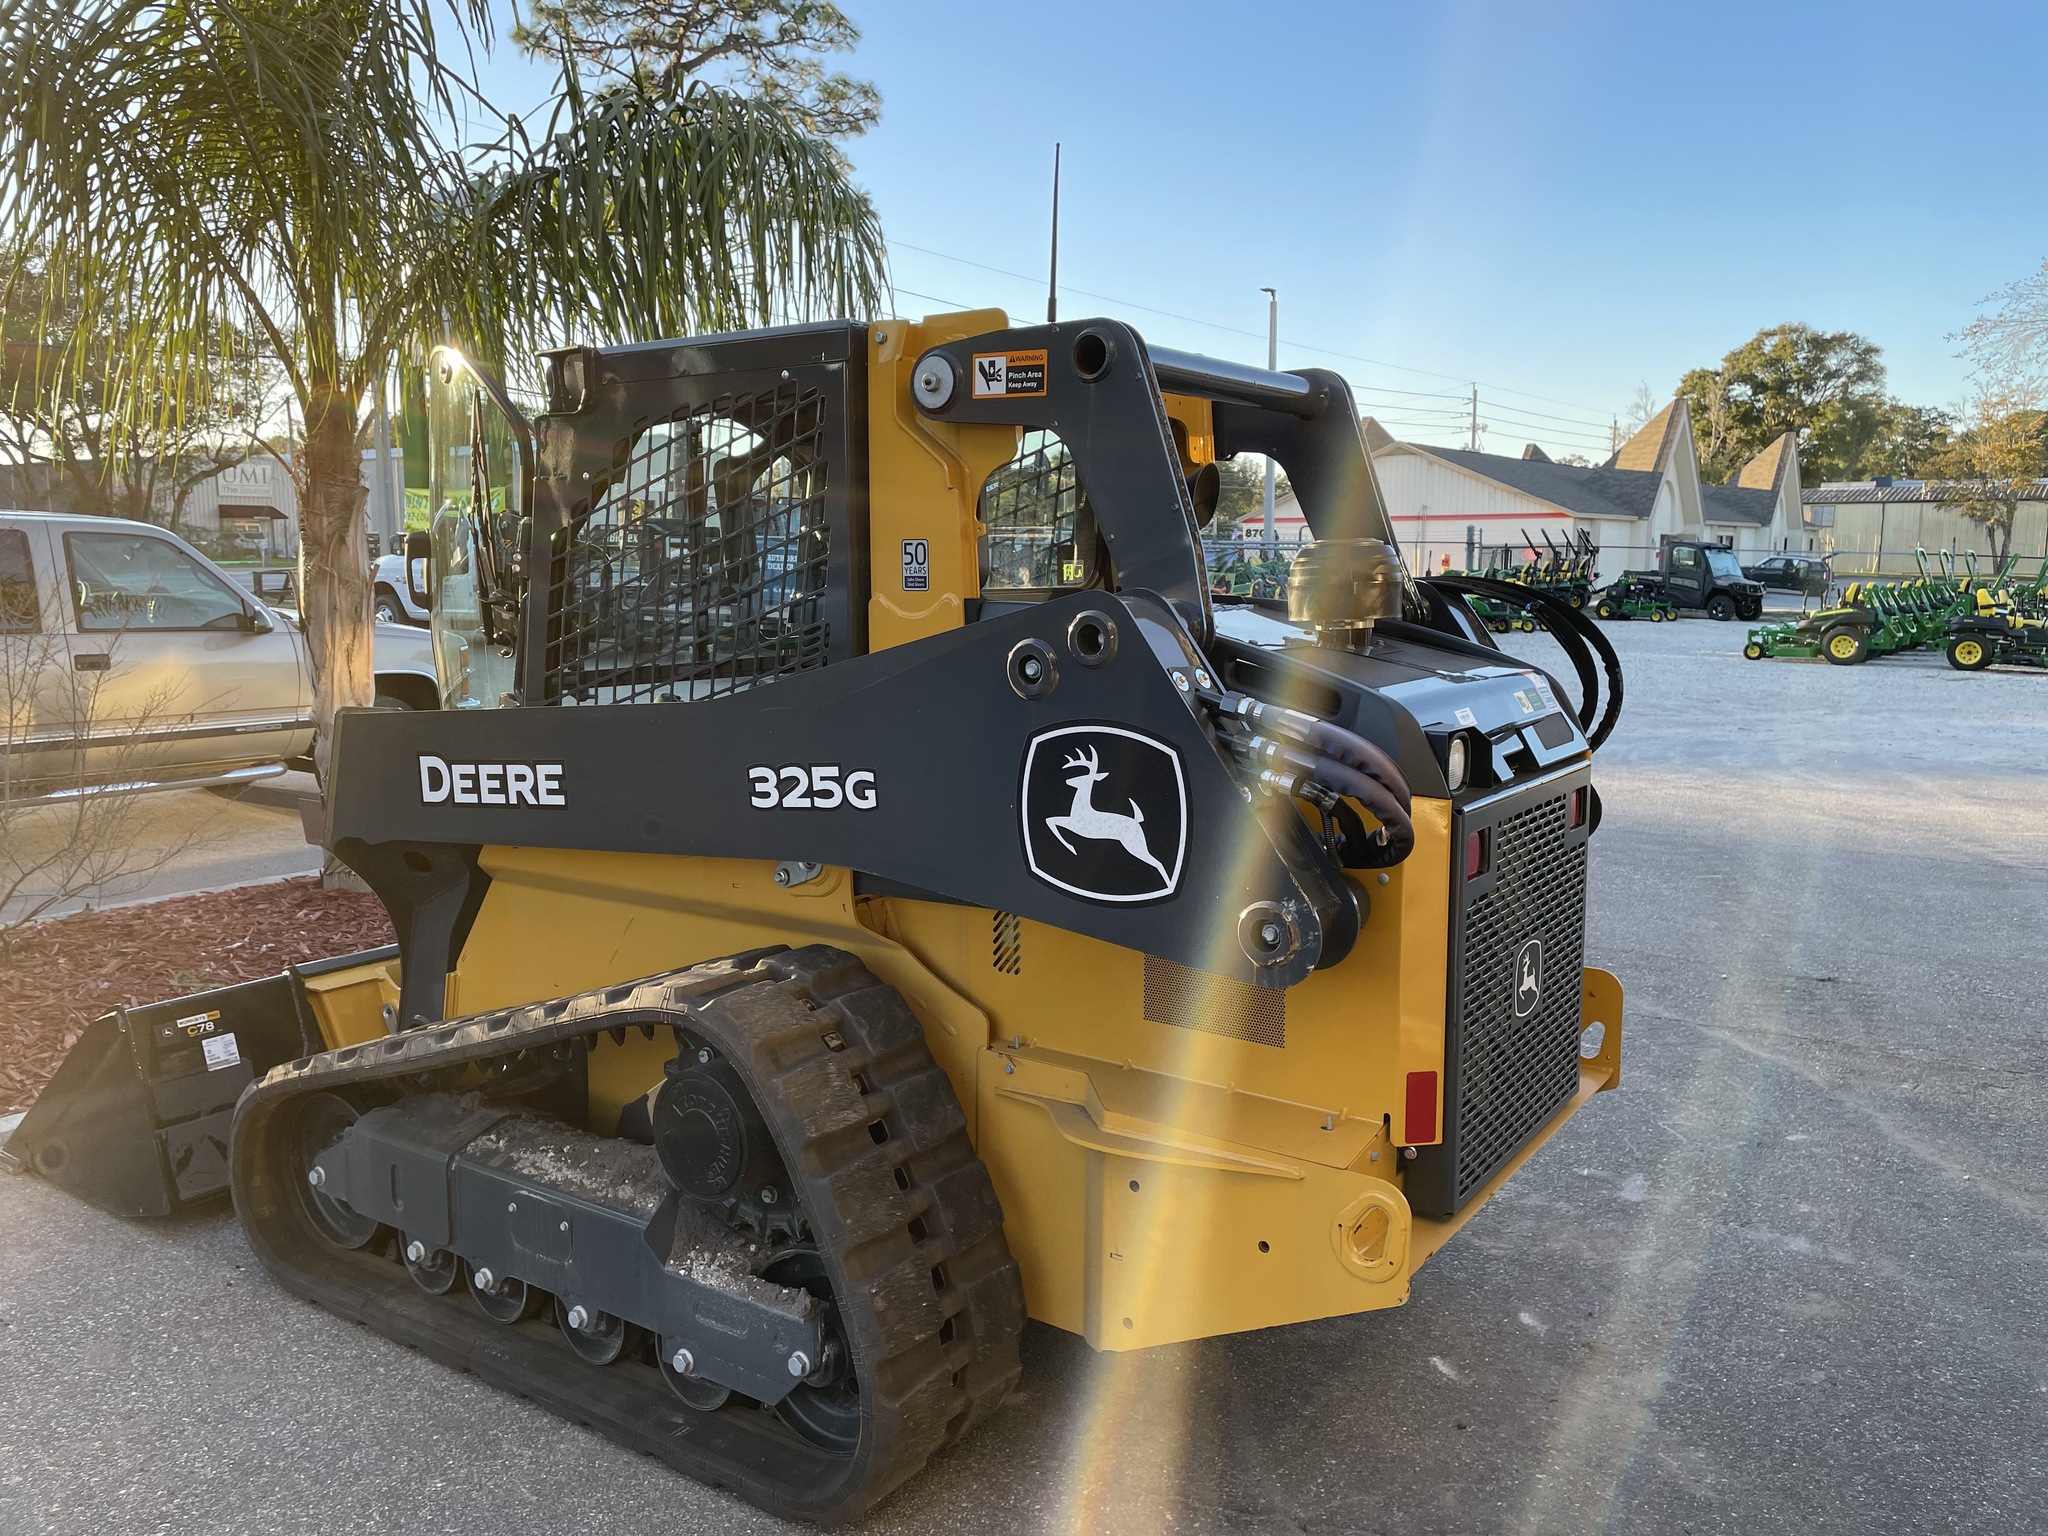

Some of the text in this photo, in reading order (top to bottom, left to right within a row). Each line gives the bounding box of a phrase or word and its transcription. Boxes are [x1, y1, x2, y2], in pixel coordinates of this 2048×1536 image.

[1015, 354, 1044, 362] WARNING
[1008, 370, 1043, 379] Pinch Area
[1008, 381, 1038, 389] Keep Away
[222, 467, 268, 485] UMI
[903, 541, 927, 566] 50
[904, 566, 927, 575] YEARS
[419, 756, 566, 806] DEERE
[748, 766, 877, 809] 325G
[187, 1021, 215, 1035] C78
